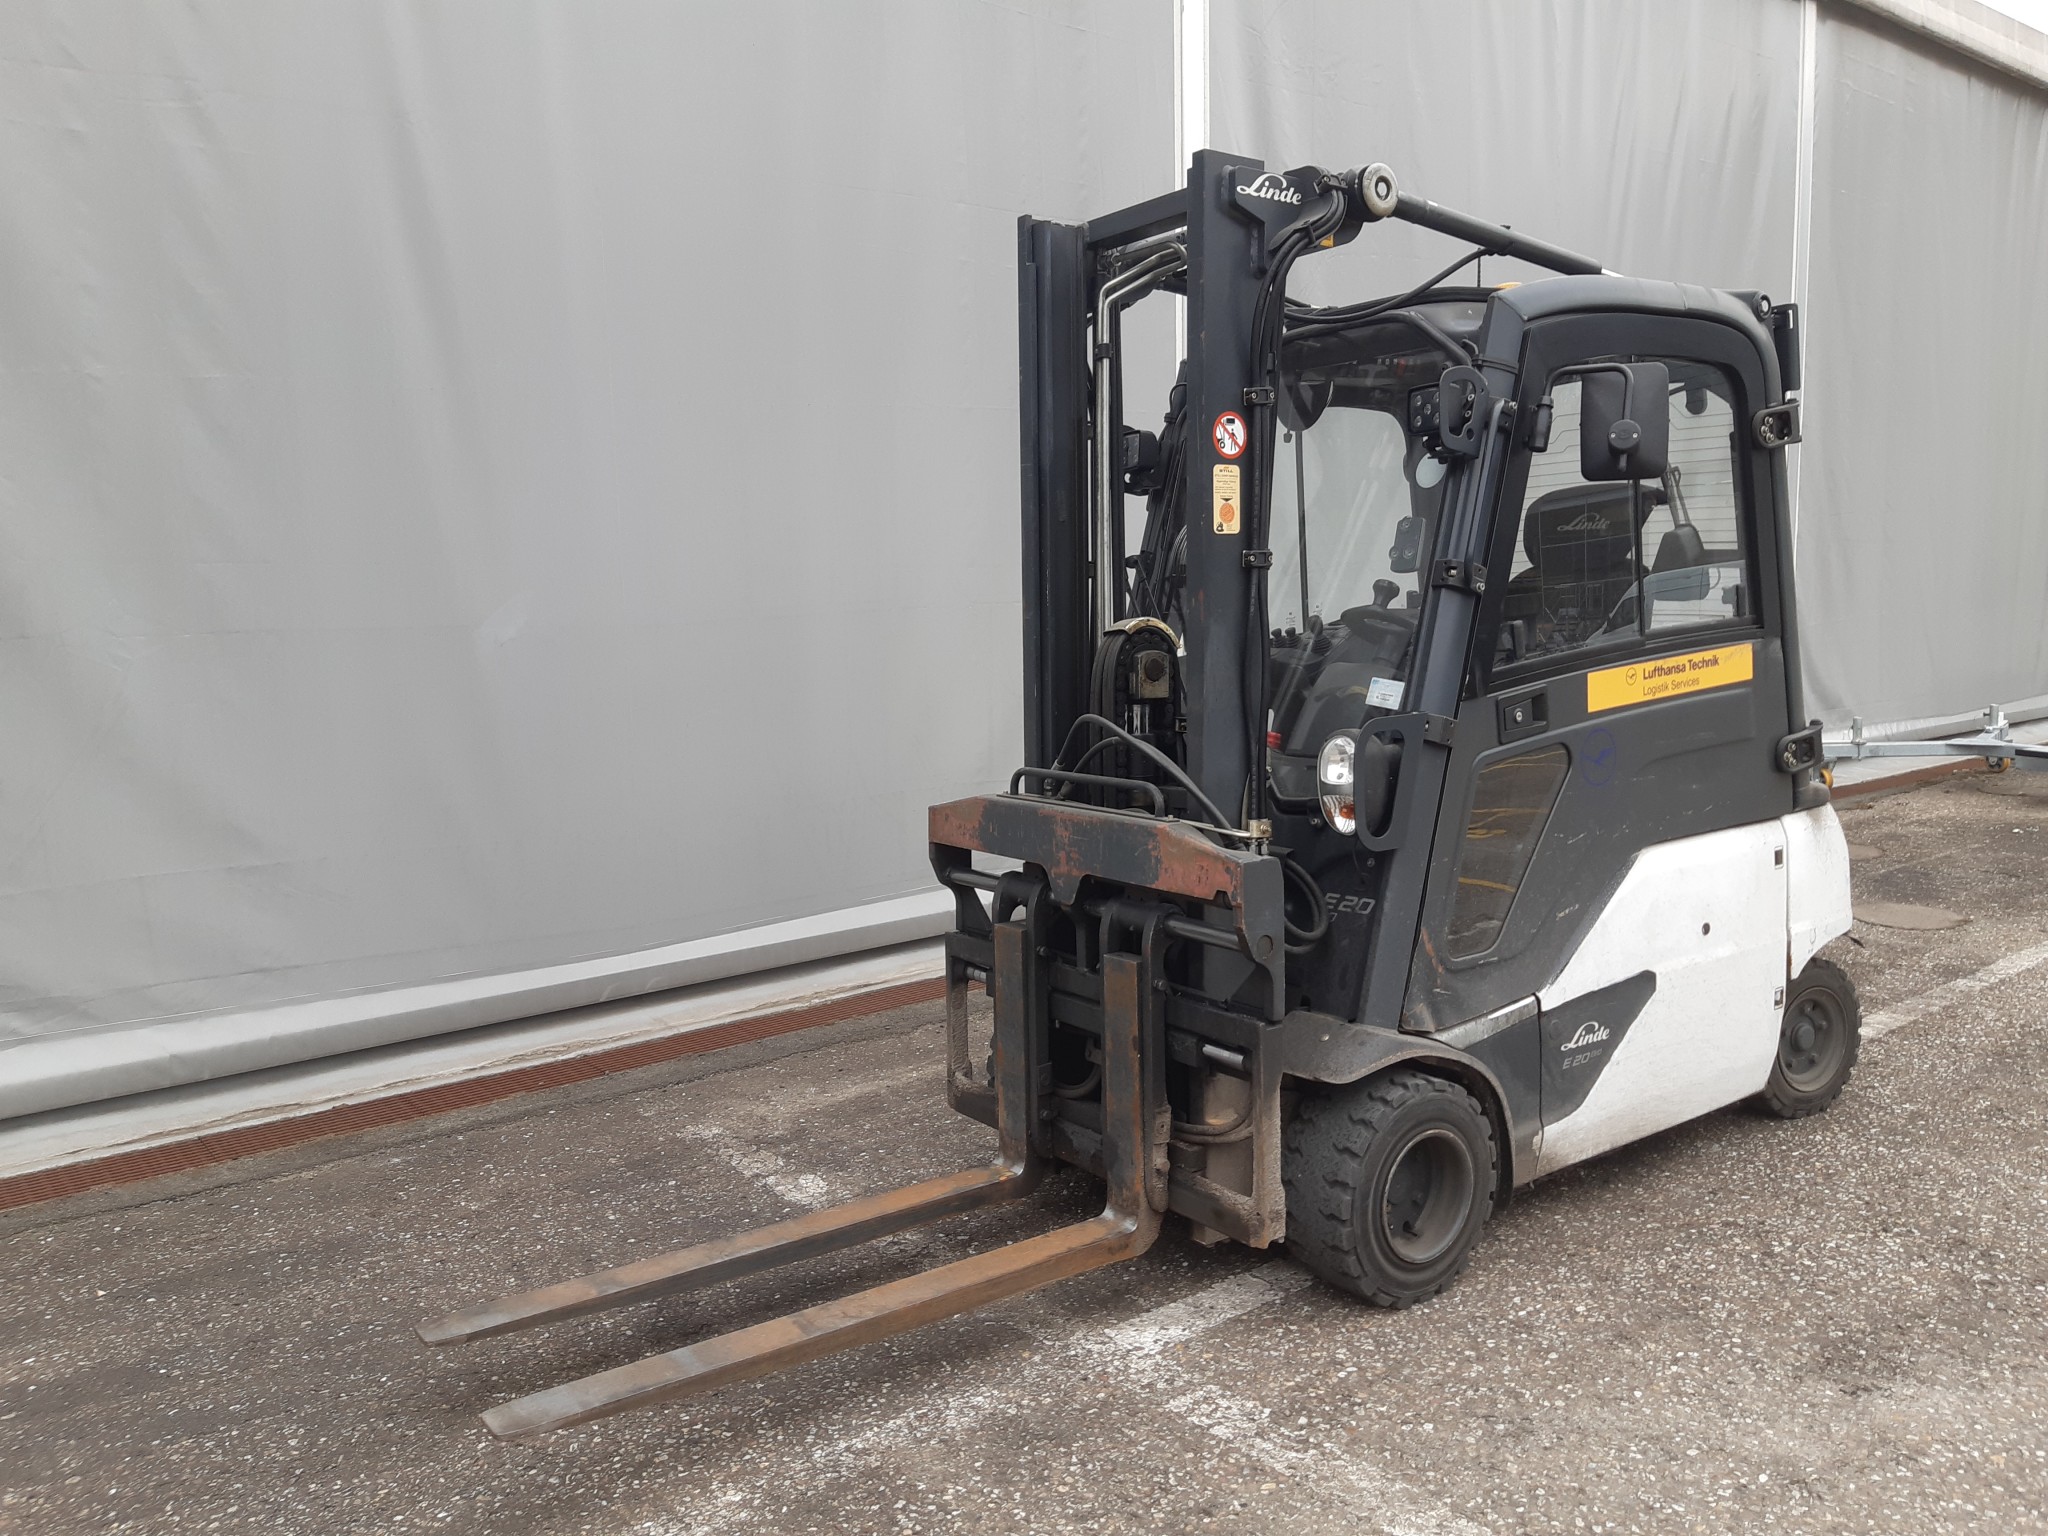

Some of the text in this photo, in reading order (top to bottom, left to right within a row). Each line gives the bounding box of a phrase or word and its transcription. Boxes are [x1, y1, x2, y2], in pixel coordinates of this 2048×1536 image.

[1236, 173, 1302, 205] Linde
[1557, 512, 1610, 531] Linde
[1642, 655, 1720, 681] Lufthansa Technik
[1642, 676, 1700, 697] Logistik Services
[1560, 1021, 1610, 1052] Linde
